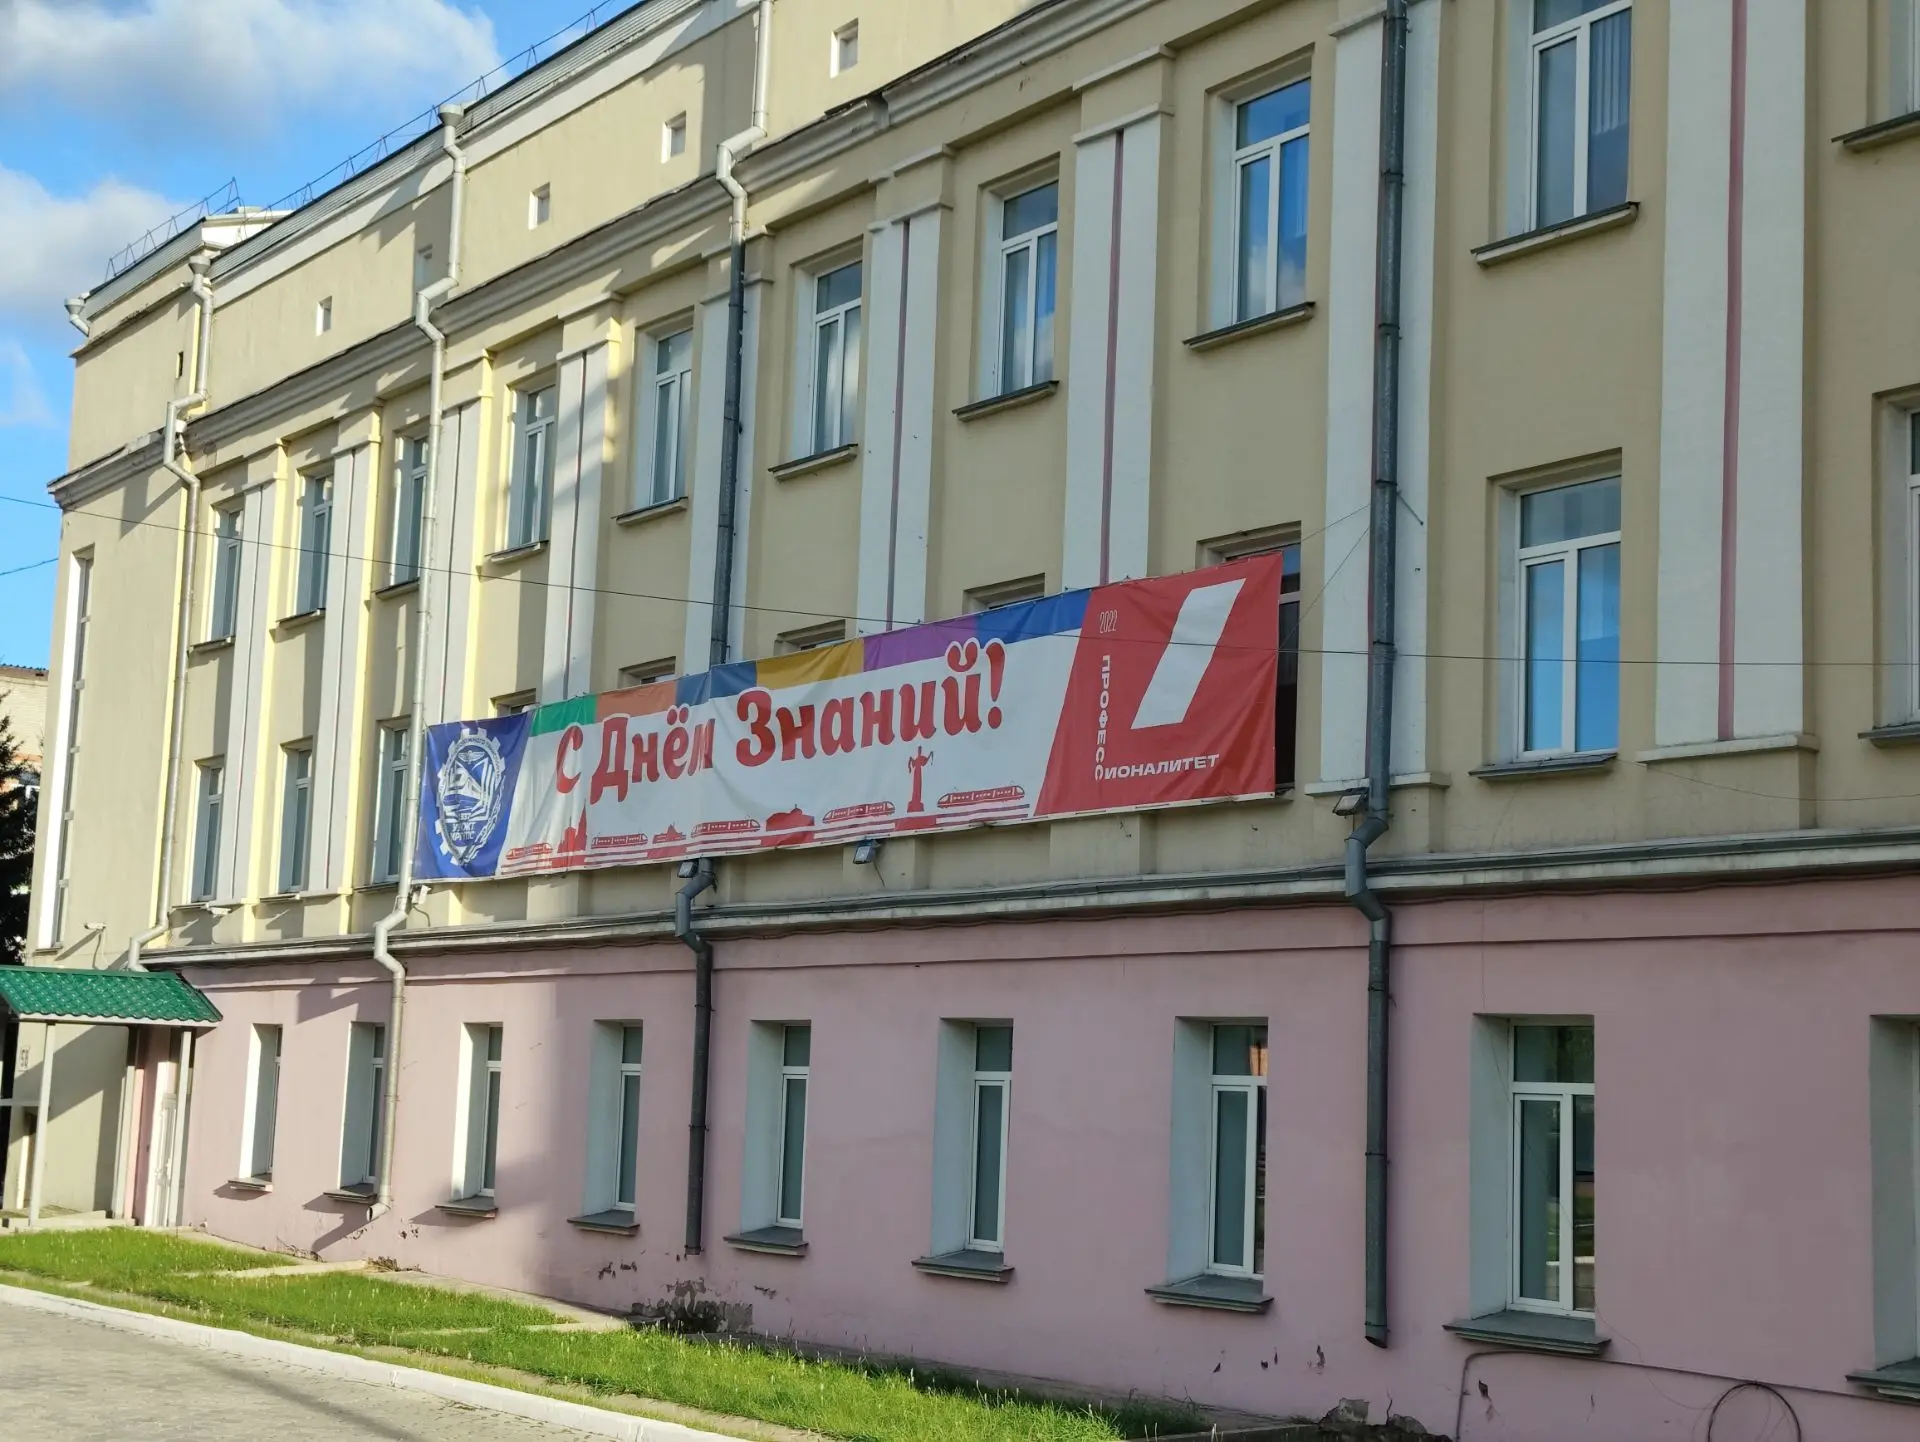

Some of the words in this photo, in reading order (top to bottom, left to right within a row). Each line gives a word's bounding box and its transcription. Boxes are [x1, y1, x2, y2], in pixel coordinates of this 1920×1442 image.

[1099, 609, 1118, 634] 2022
[556, 724, 584, 794] С
[589, 706, 716, 805] Днём
[736, 642, 1006, 767] Знаний!
